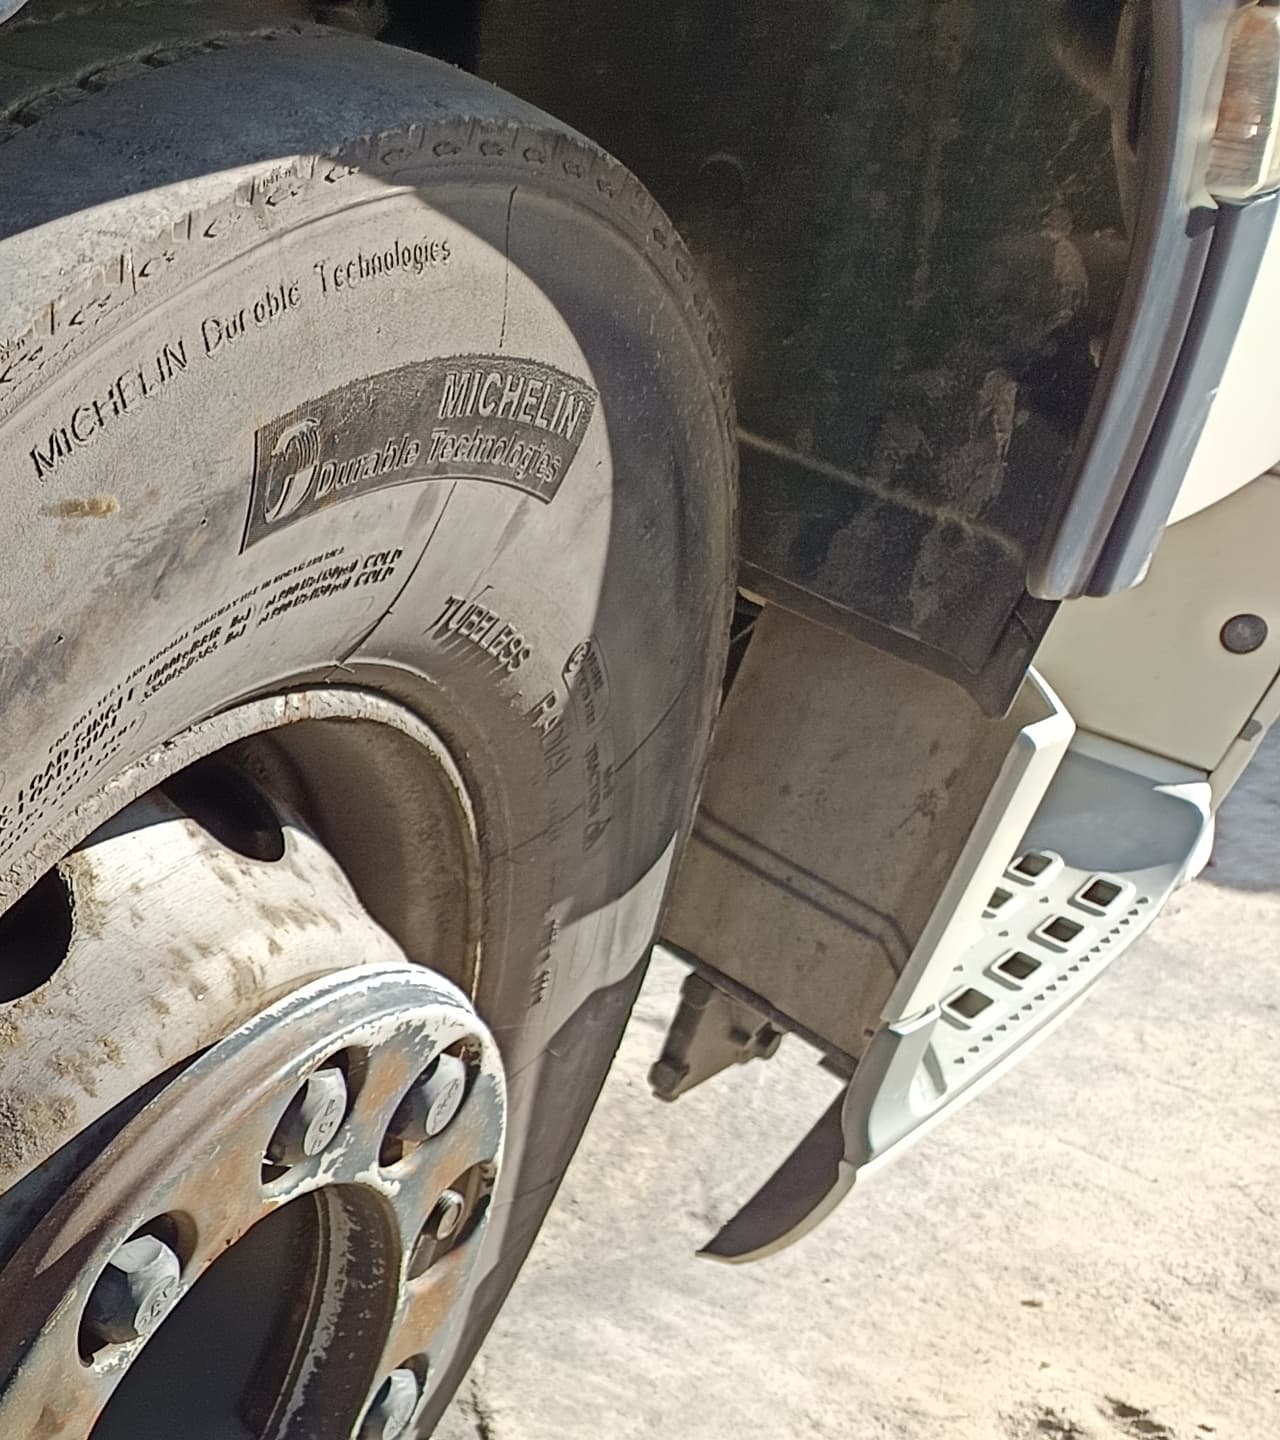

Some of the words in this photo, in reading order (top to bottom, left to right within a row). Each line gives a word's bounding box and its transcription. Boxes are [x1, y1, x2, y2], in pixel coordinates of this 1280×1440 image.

[29, 341, 188, 480] MICHELIN
[200, 280, 302, 359] Durable
[313, 237, 453, 294] Technologies
[439, 372, 588, 442] MICHELIN
[315, 434, 420, 500] Durable
[429, 427, 562, 486] Technologies
[440, 594, 534, 674] TUBELESS
